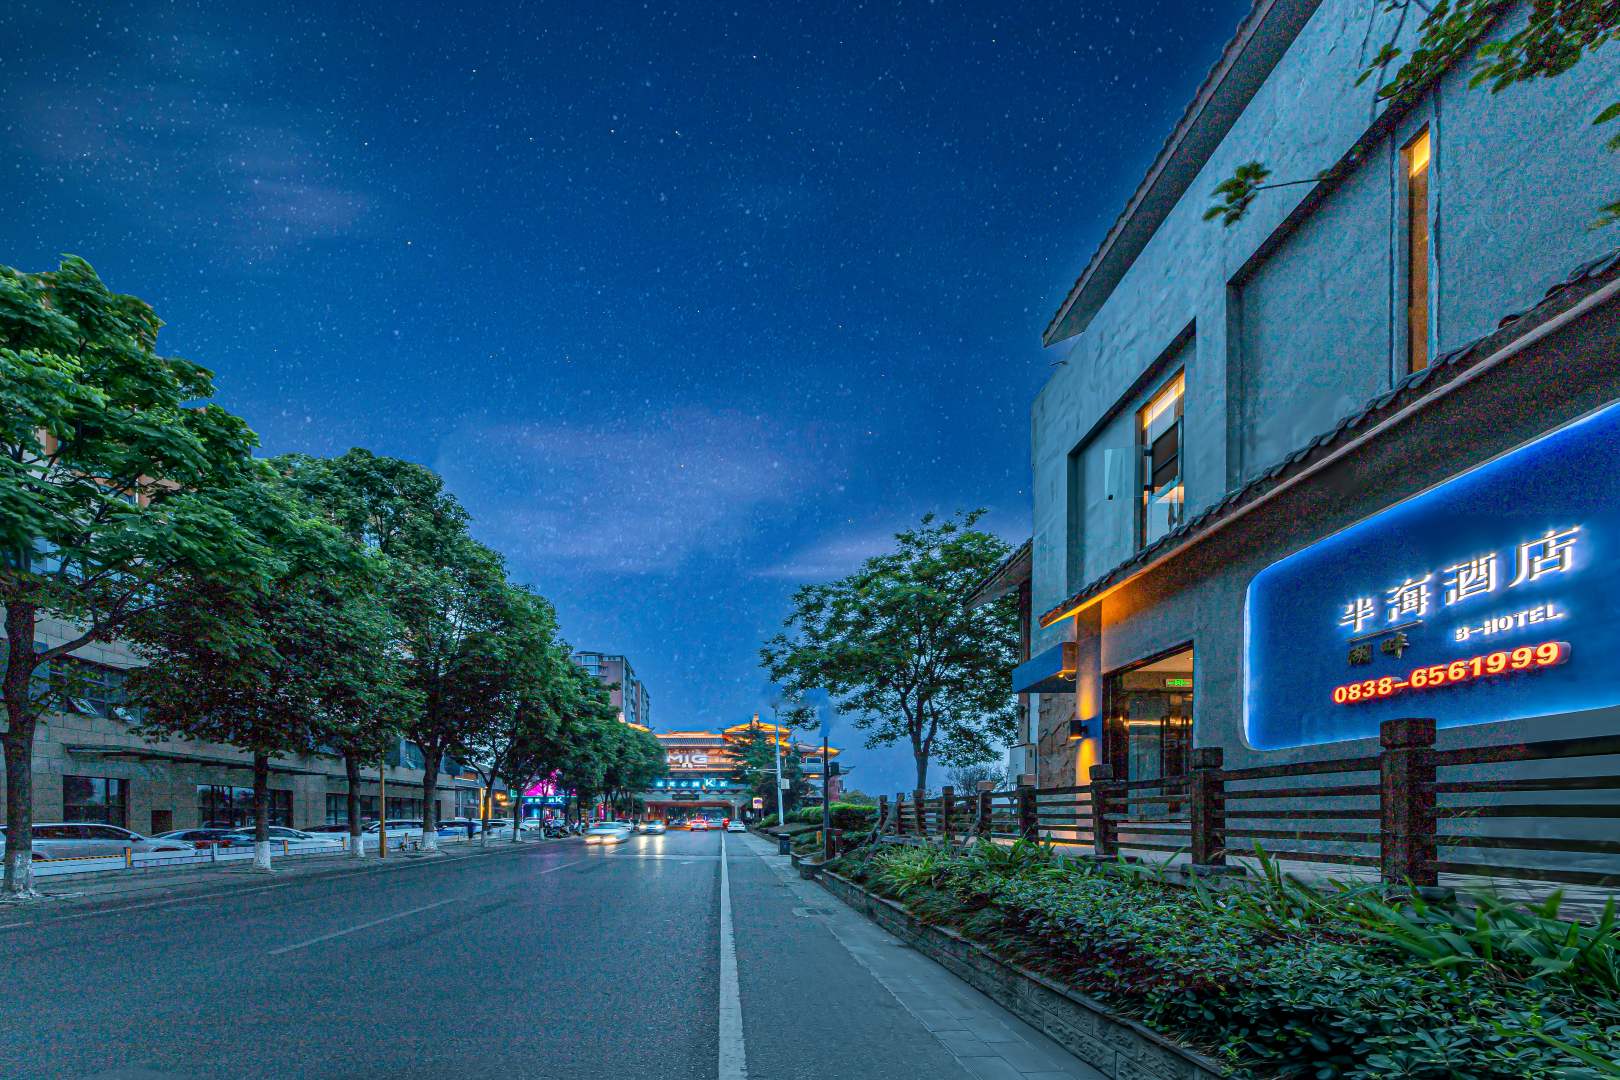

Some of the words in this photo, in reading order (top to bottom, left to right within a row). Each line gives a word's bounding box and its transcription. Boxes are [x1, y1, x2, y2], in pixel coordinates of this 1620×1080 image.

[1338, 527, 1581, 633] 半海酒店
[1454, 603, 1565, 641] B-HOTEL
[1333, 641, 1561, 704] 0838-6561999
